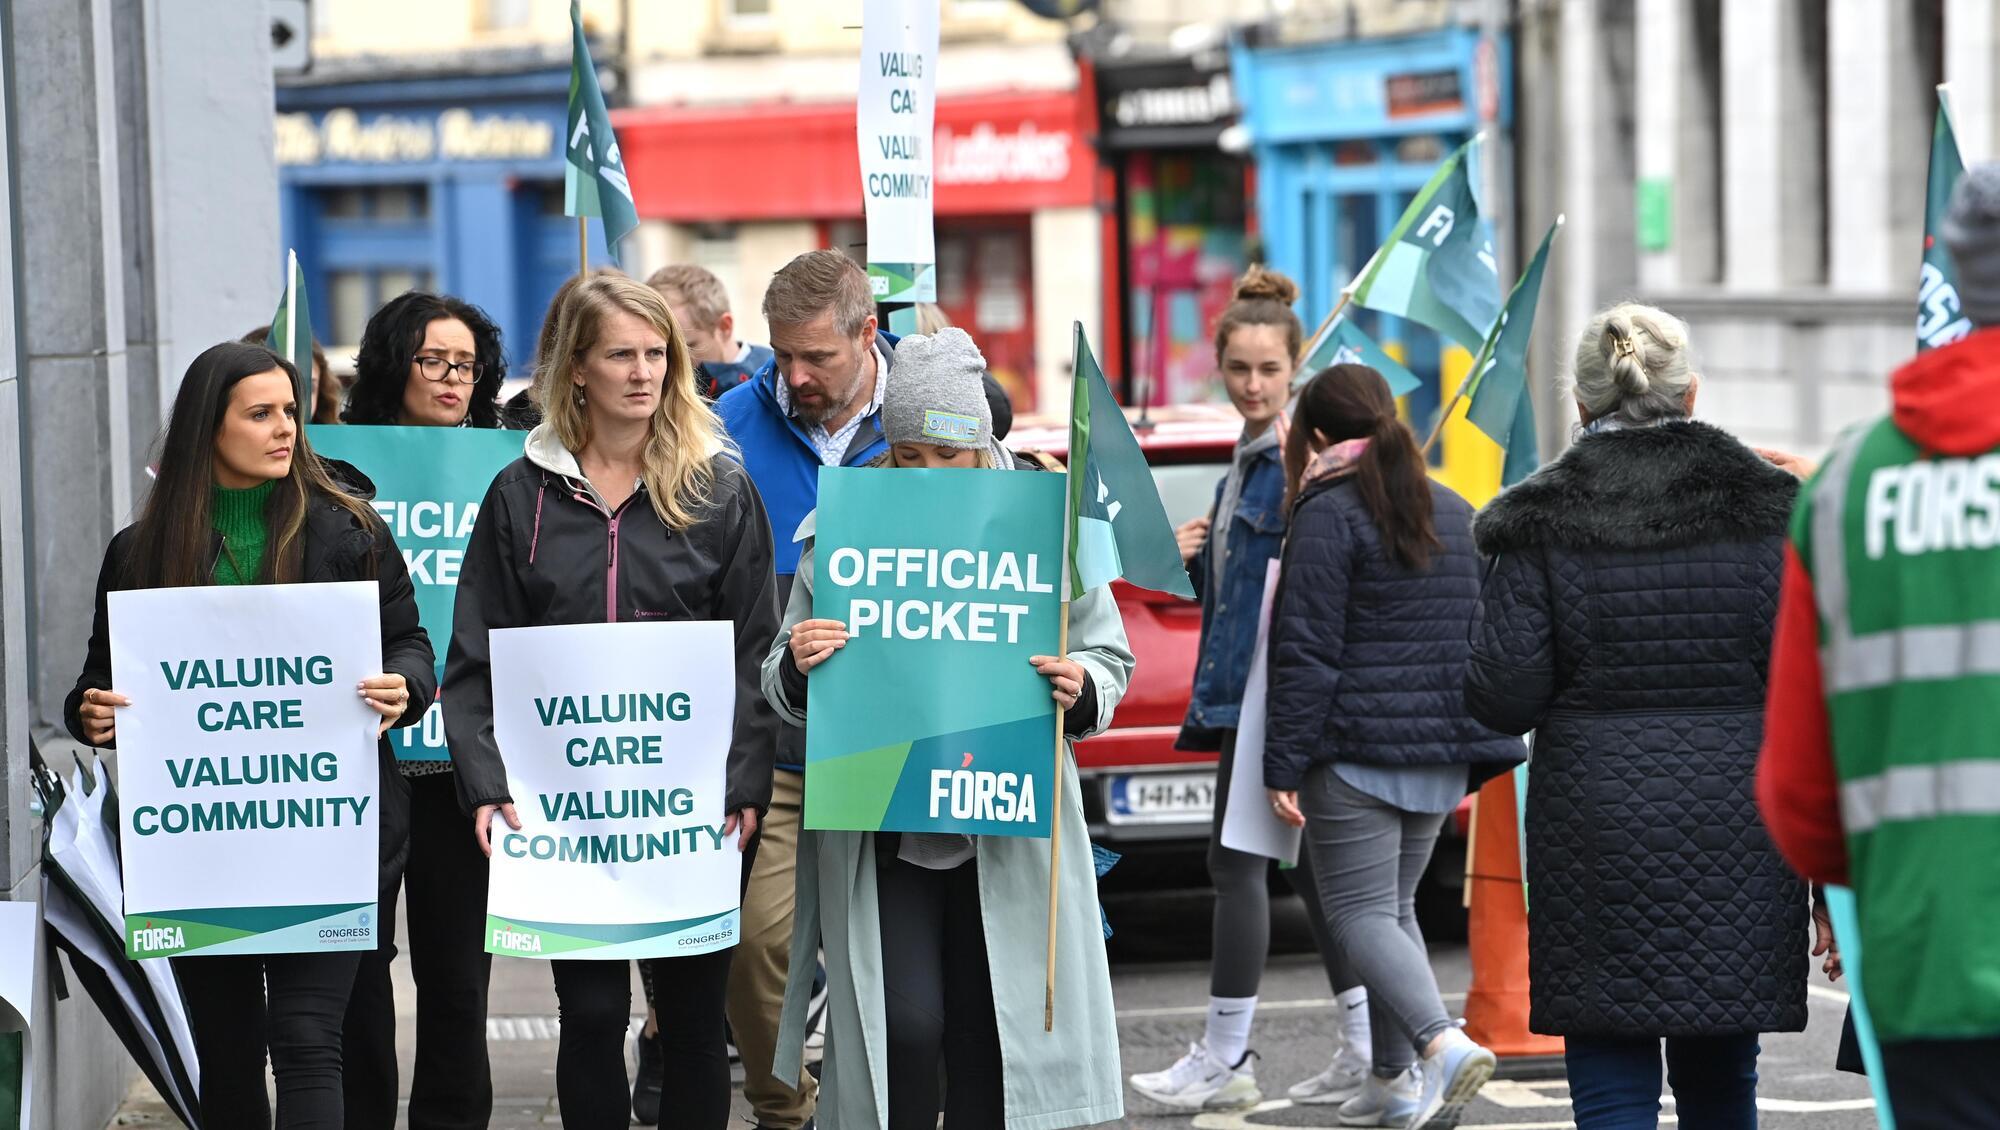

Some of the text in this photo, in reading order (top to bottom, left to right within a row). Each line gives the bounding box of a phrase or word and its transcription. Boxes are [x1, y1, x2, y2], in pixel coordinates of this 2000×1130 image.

[829, 548, 1053, 593] OFFICIAL
[849, 599, 1029, 643] PICKET
[160, 656, 333, 690] VALUING
[198, 700, 304, 732] CARE
[534, 692, 690, 726] VALUING
[566, 736, 662, 767] CARE
[165, 752, 337, 788] VALUING
[539, 788, 693, 821] VALUING
[929, 752, 1036, 823] FÓRSA
[133, 796, 370, 835] COMMUNITY
[504, 824, 726, 863] COMMUNITY
[318, 928, 370, 938] CONGRESS
[678, 929, 733, 945] CONGRESS
